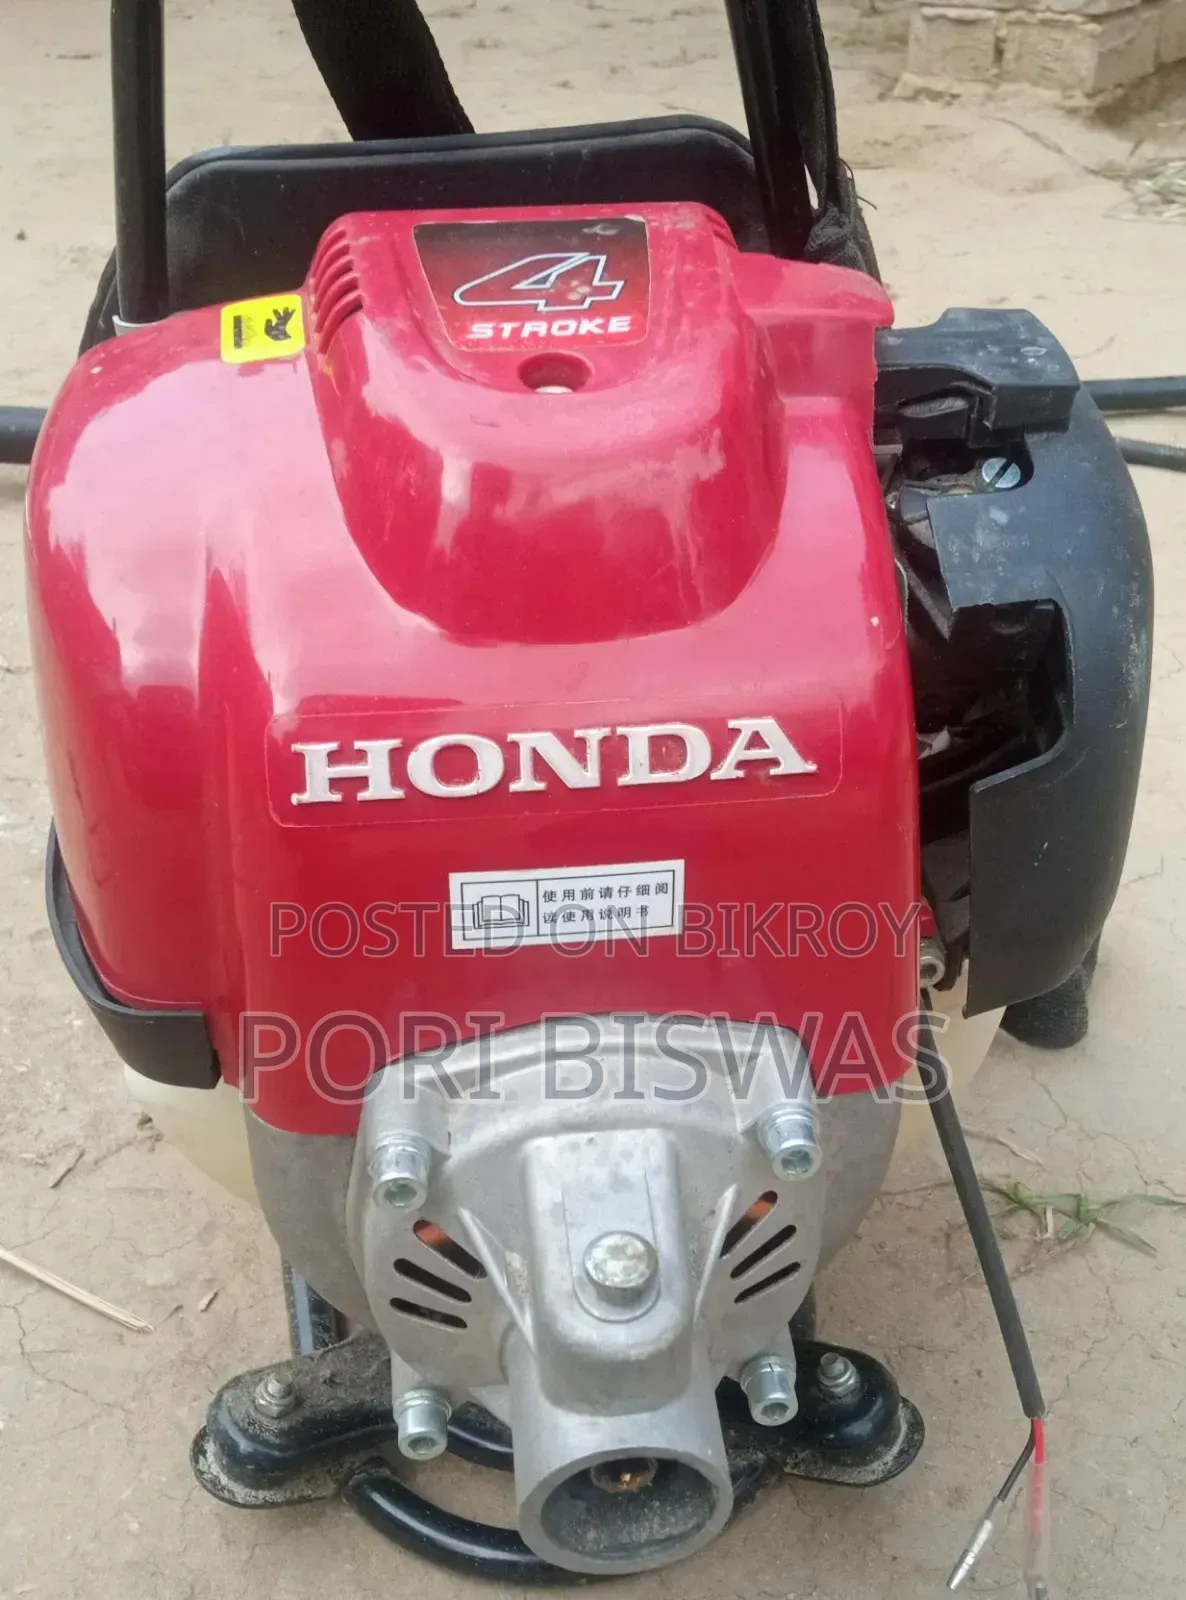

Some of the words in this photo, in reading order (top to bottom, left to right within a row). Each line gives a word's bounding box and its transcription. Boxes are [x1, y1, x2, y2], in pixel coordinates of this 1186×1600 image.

[453, 251, 627, 312] 4
[466, 315, 632, 340] STROKE
[290, 715, 818, 807] HONDA
[542, 882, 669, 904] 使用前请仔细阅
